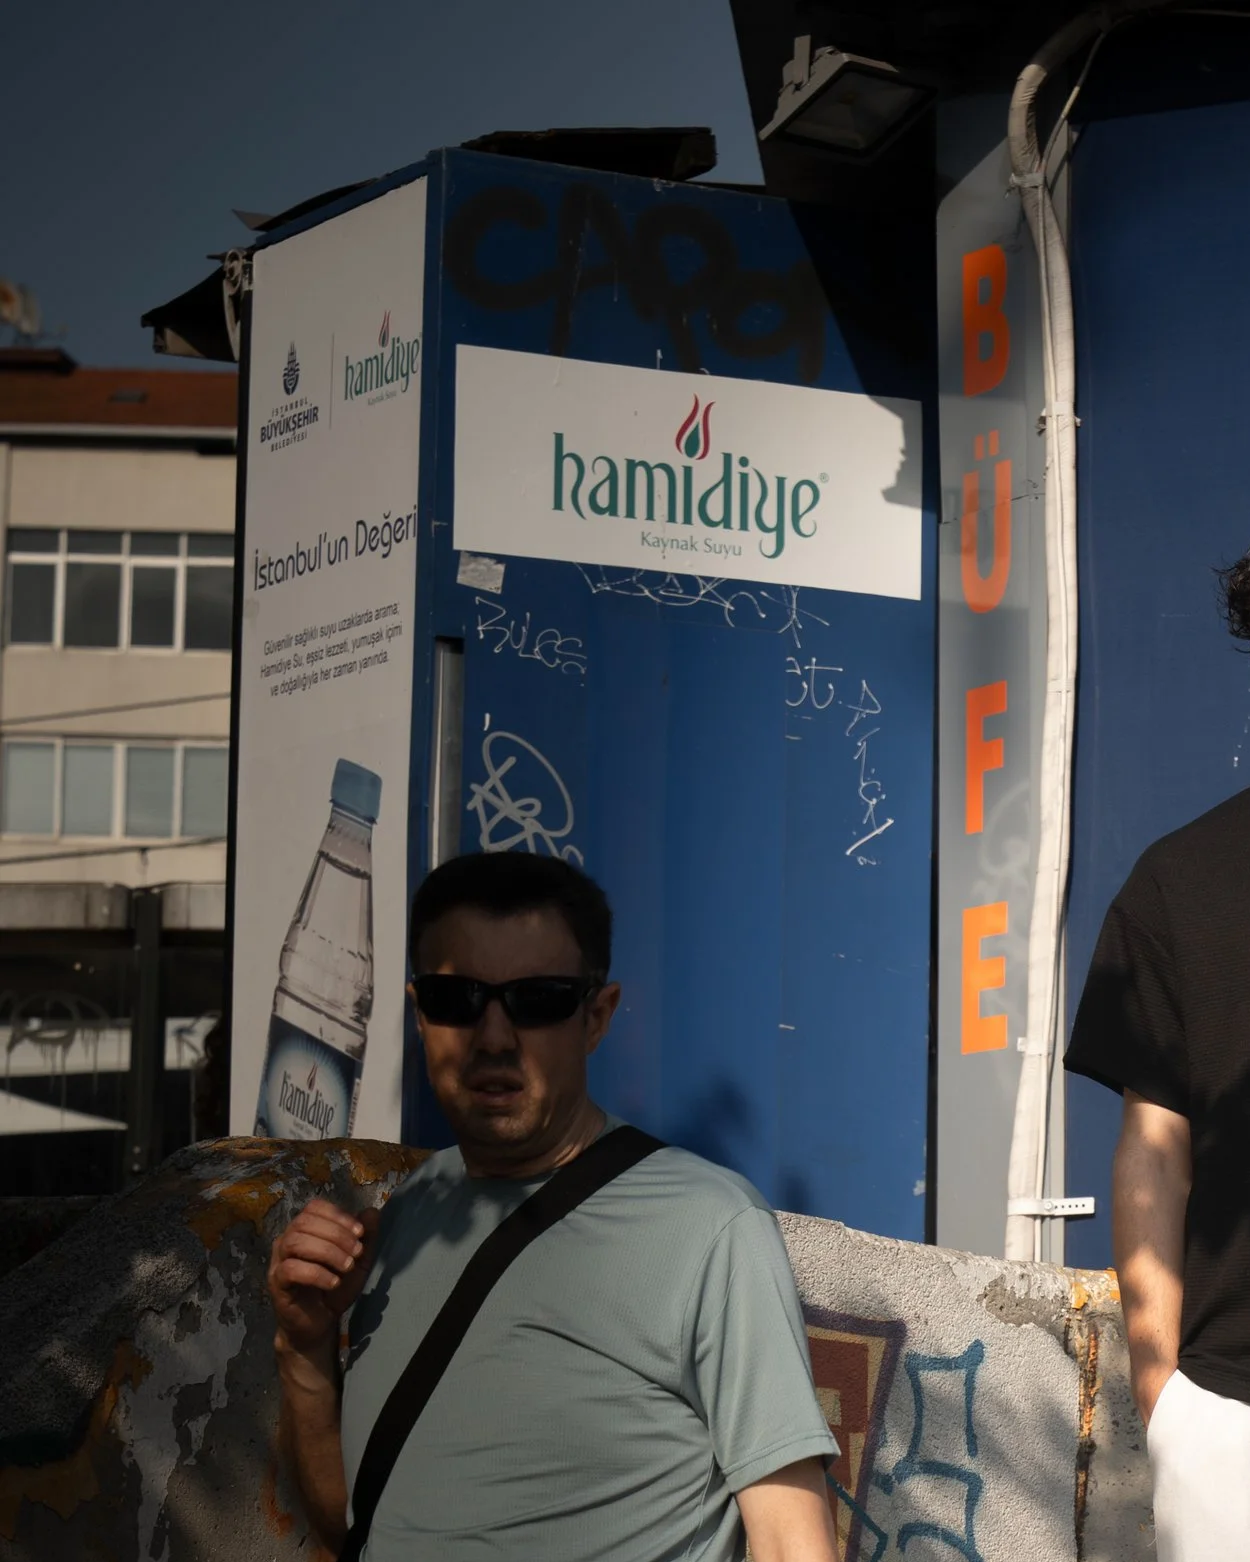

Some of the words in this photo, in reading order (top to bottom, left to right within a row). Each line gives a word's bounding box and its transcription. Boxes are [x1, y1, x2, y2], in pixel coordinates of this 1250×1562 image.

[344, 336, 420, 401] hamidiye
[260, 403, 319, 443] BÜYÜKŞEHİR
[271, 396, 309, 418] İSTANBUL
[270, 429, 308, 453] BELEDİYESİ
[552, 431, 820, 559] hamidiye
[355, 504, 417, 559] Değeri
[640, 531, 698, 556] Kaynak
[703, 537, 742, 559] Suyu
[320, 621, 337, 639] suyu
[338, 608, 373, 633] uzaklarda
[260, 658, 292, 679] Hamidiye
[306, 644, 325, 665] eşsiz
[351, 629, 383, 654] yumuşak
[385, 621, 403, 644] içimi
[962, 243, 1013, 1056] BÜFE
[270, 682, 279, 696] ve
[320, 667, 331, 682] her
[333, 659, 357, 678] zaman
[278, 1070, 334, 1140] hamidiye
